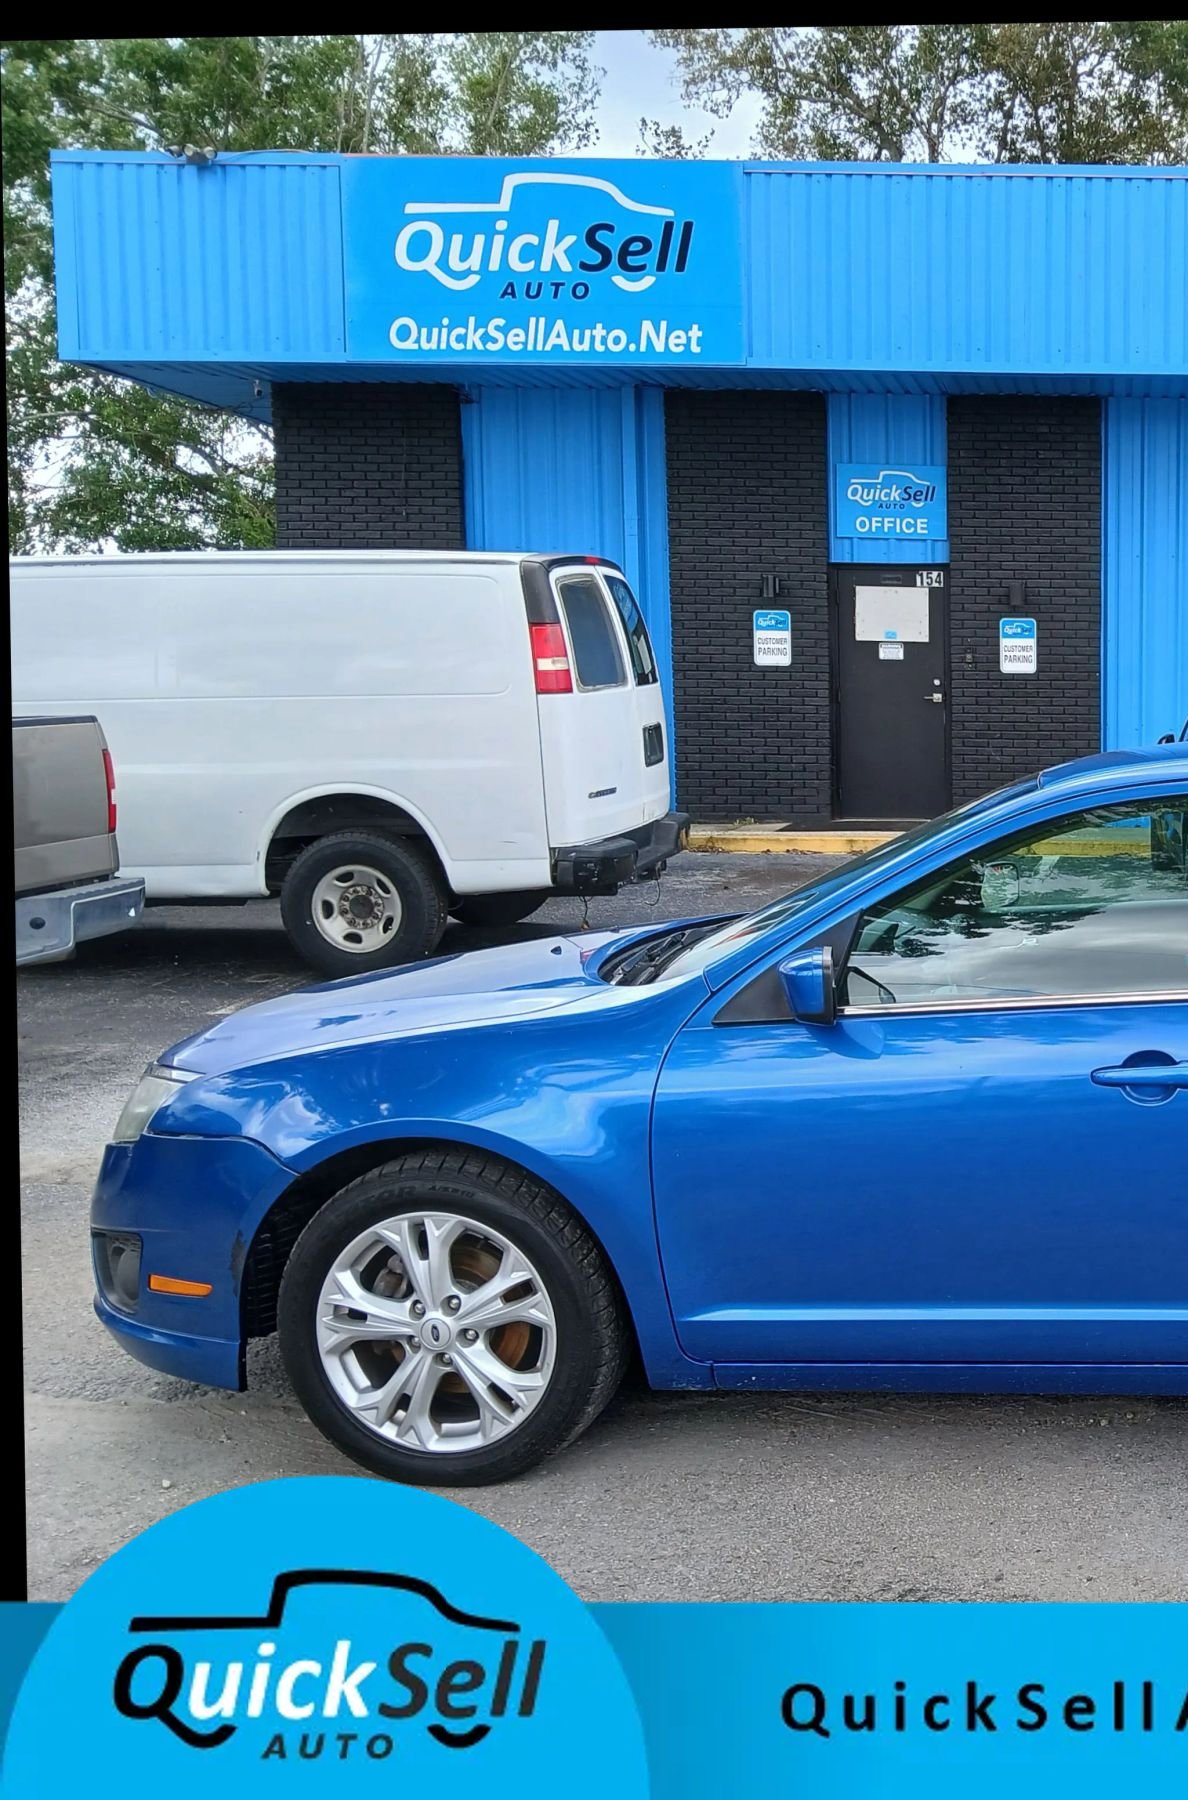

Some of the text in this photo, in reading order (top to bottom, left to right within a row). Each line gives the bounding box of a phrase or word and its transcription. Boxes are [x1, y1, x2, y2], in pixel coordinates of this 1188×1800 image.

[394, 218, 694, 292] QuickSell
[499, 281, 590, 300] AUTO
[388, 315, 703, 354] QuickSellAuto.Net
[847, 483, 936, 506] QuickSell
[855, 516, 929, 534] OFFICE
[919, 571, 943, 587] 154
[757, 637, 787, 645] CUSTOMER
[1003, 645, 1033, 653] CUSTOMER
[757, 647, 787, 656] PARKING
[1003, 654, 1033, 664] PARKING
